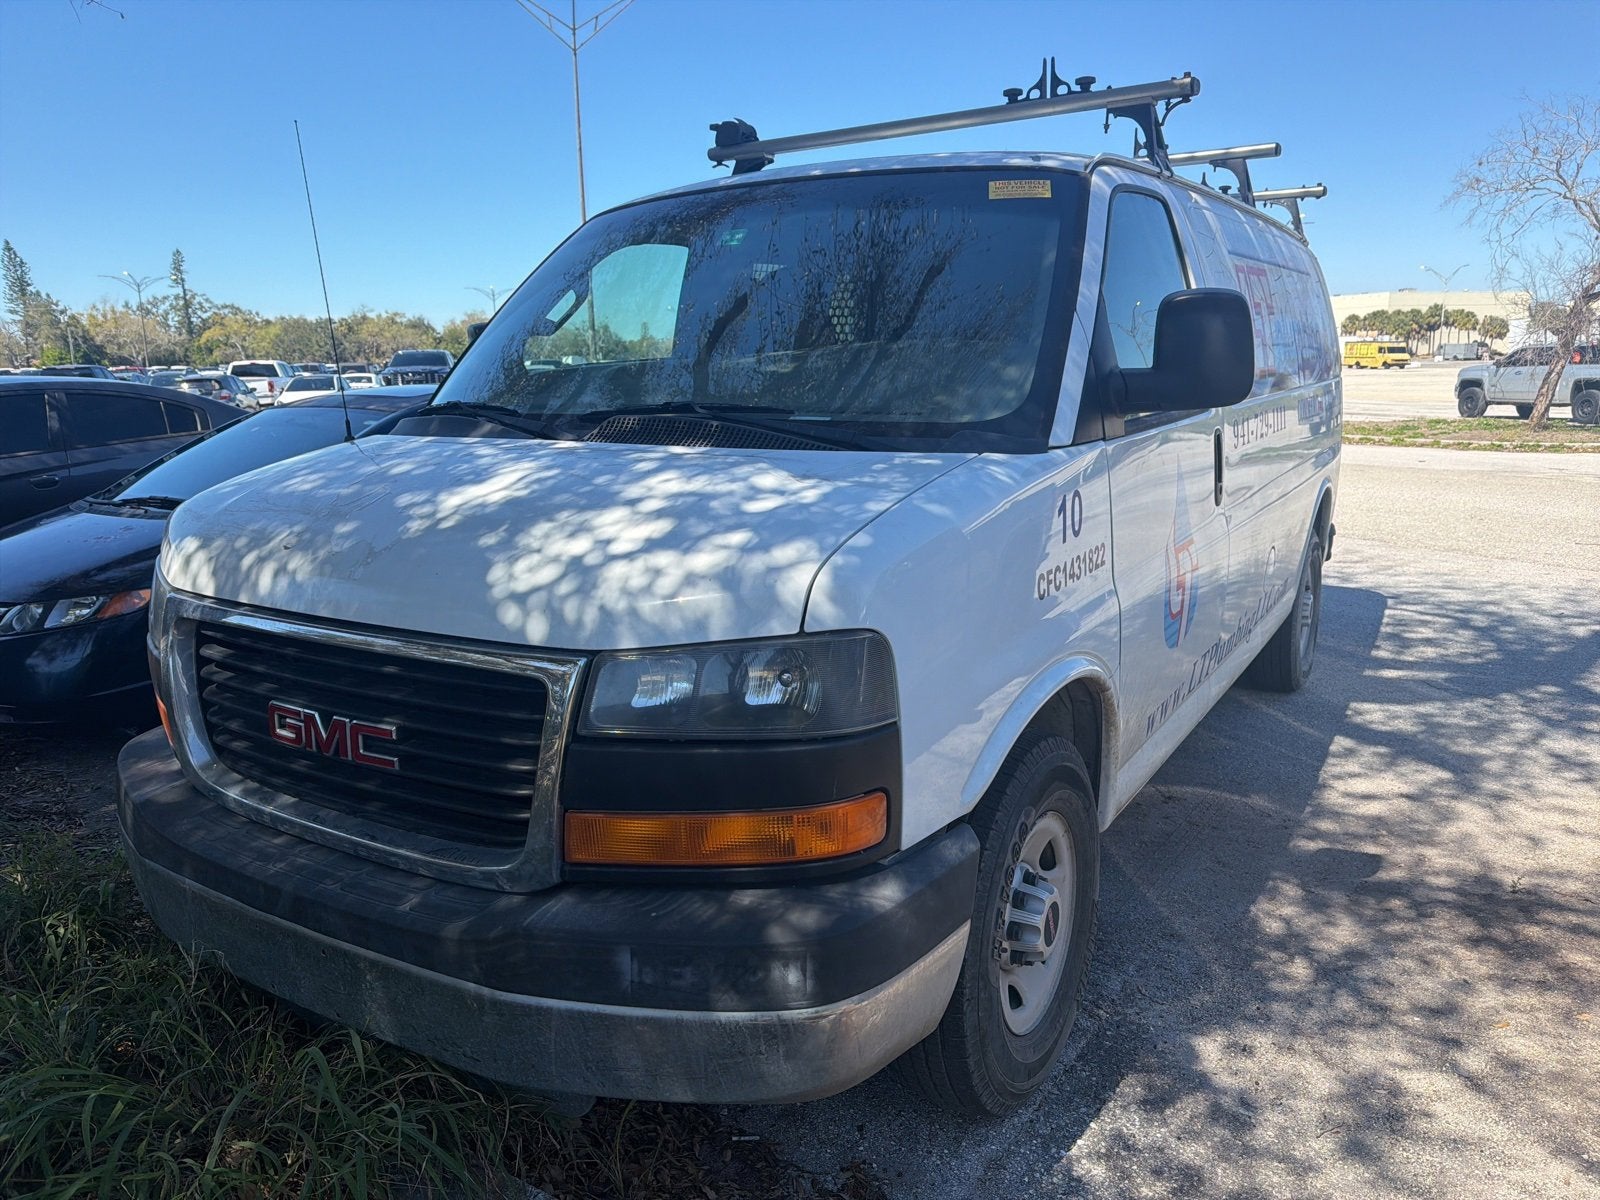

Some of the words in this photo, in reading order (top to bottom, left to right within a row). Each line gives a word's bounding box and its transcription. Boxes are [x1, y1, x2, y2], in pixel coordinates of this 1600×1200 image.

[1057, 489, 1083, 544] 10
[1037, 542, 1106, 601] CFC1431822
[268, 699, 400, 771] GMC
